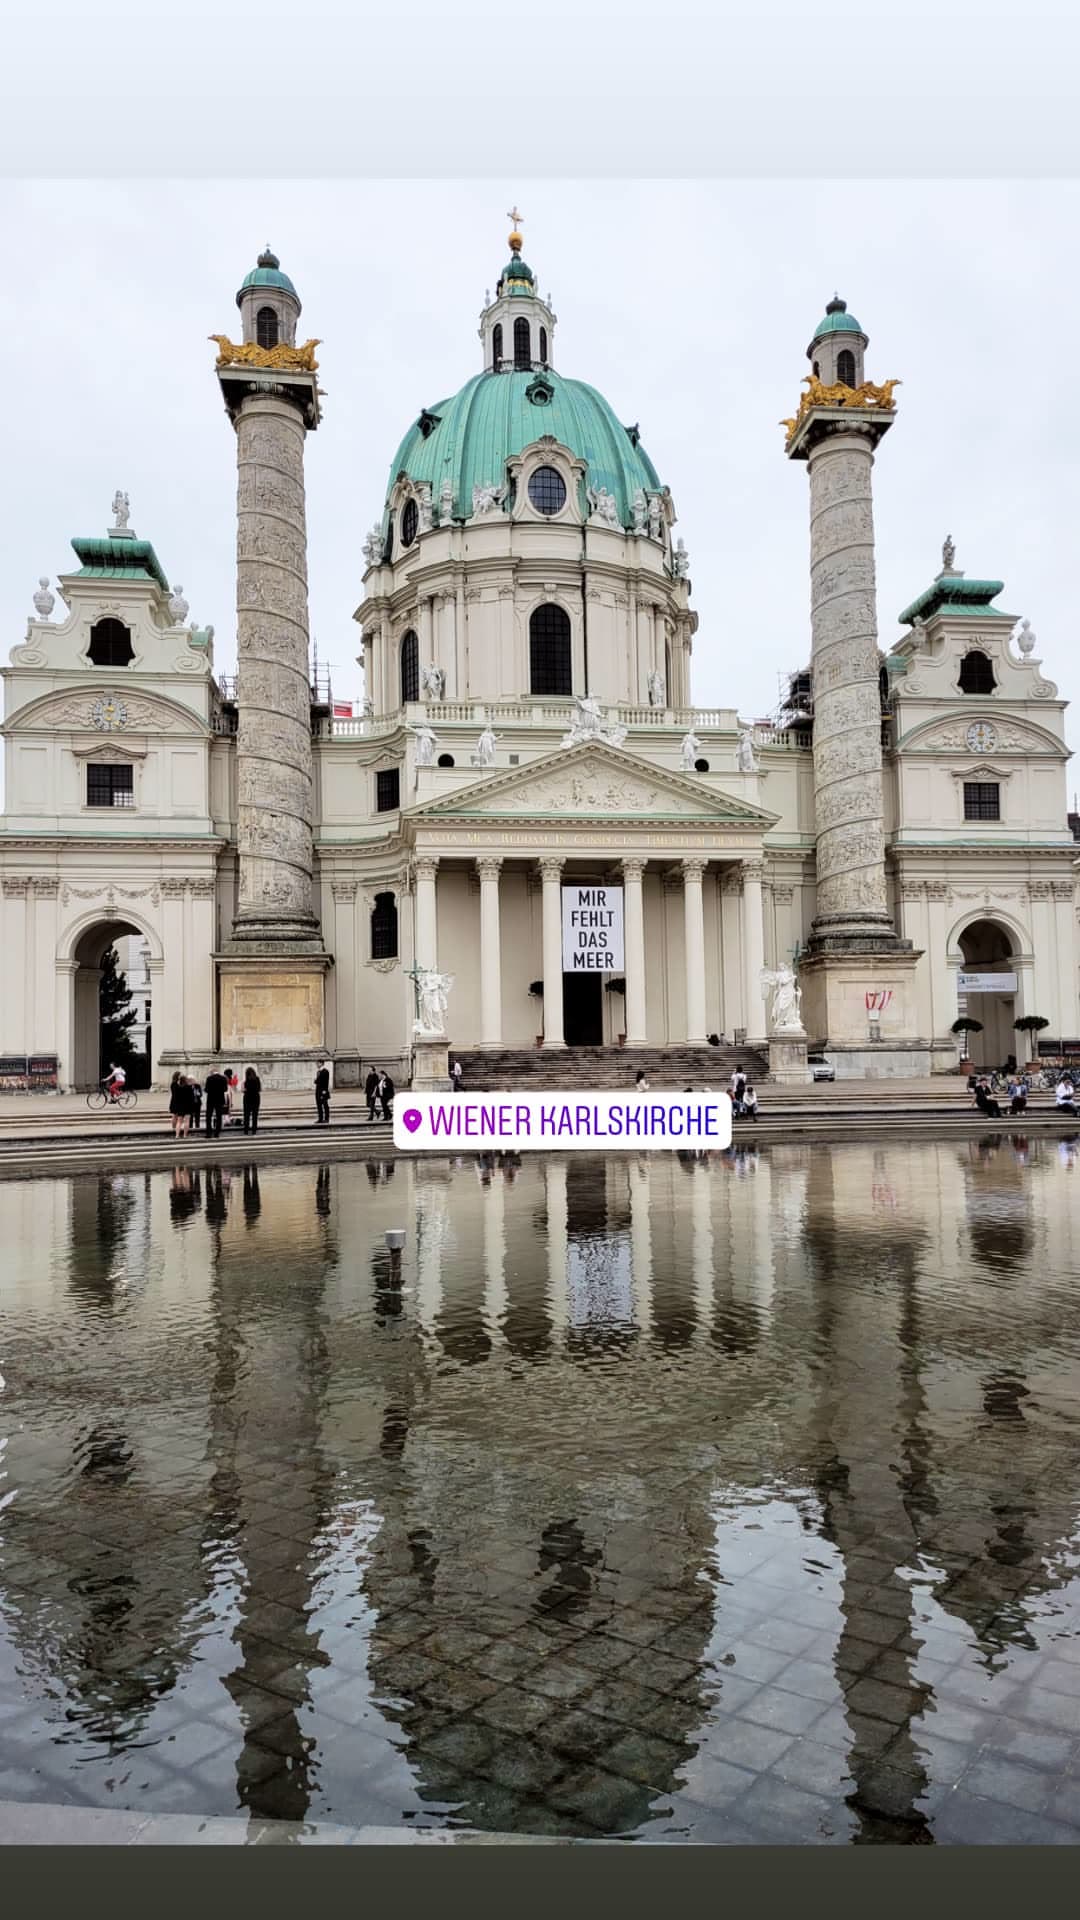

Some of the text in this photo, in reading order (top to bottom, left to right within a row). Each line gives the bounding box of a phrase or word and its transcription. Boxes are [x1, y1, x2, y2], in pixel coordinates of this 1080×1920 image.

[578, 890, 606, 906] MIR
[571, 911, 615, 927] FEHLT
[578, 931, 607, 948] DAS
[573, 952, 614, 968] MEER
